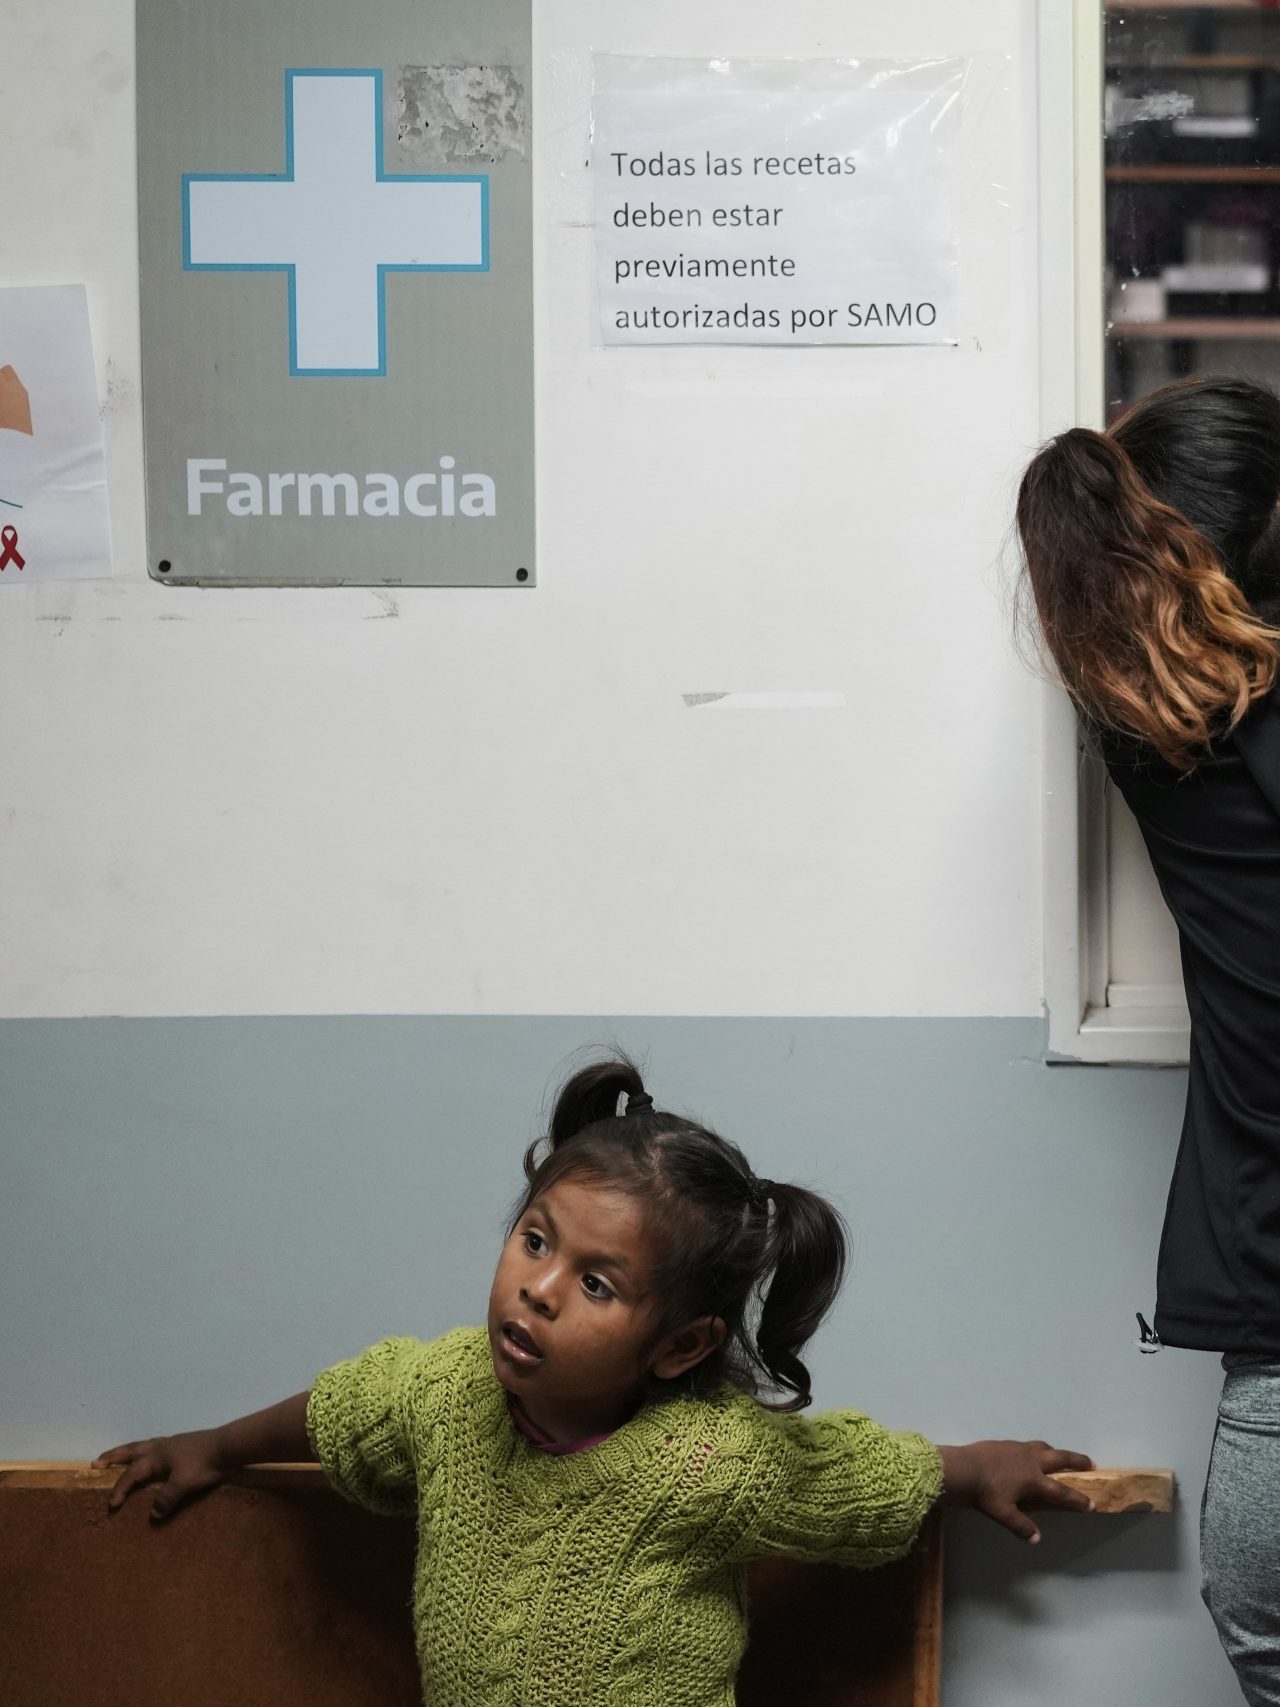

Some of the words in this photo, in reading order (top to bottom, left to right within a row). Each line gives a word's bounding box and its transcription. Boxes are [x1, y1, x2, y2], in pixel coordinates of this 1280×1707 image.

[610, 151, 695, 177] Todas
[706, 150, 742, 176] las
[753, 152, 856, 175] recetas
[613, 202, 702, 228] deben
[712, 206, 784, 227] estar
[615, 253, 796, 284] previamente
[615, 303, 780, 329] autorizadas
[791, 306, 838, 333] por
[847, 302, 937, 328] SAMO
[186, 455, 496, 517] Farmacia
